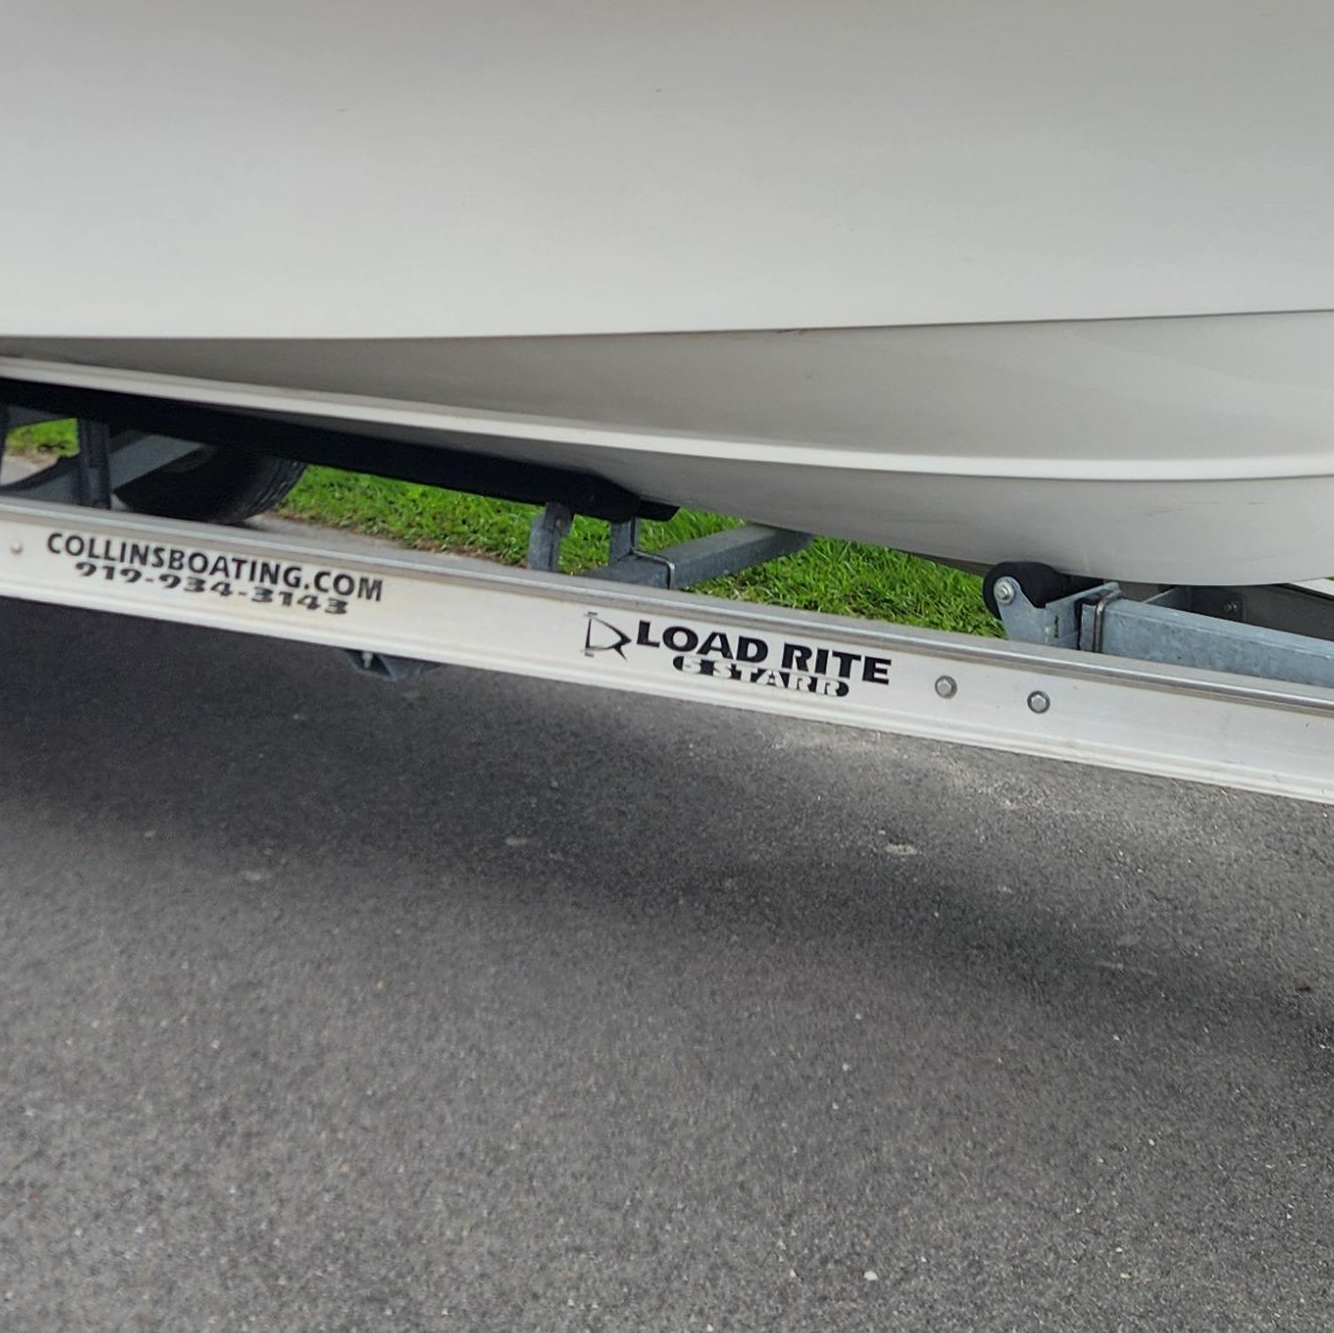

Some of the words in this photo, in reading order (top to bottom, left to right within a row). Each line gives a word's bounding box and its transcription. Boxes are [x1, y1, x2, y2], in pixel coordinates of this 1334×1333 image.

[47, 532, 383, 602] COLLINSBOATING.COM
[75, 561, 348, 615] 919-934-3143
[636, 619, 769, 664] LOAD
[781, 642, 892, 685] RITE
